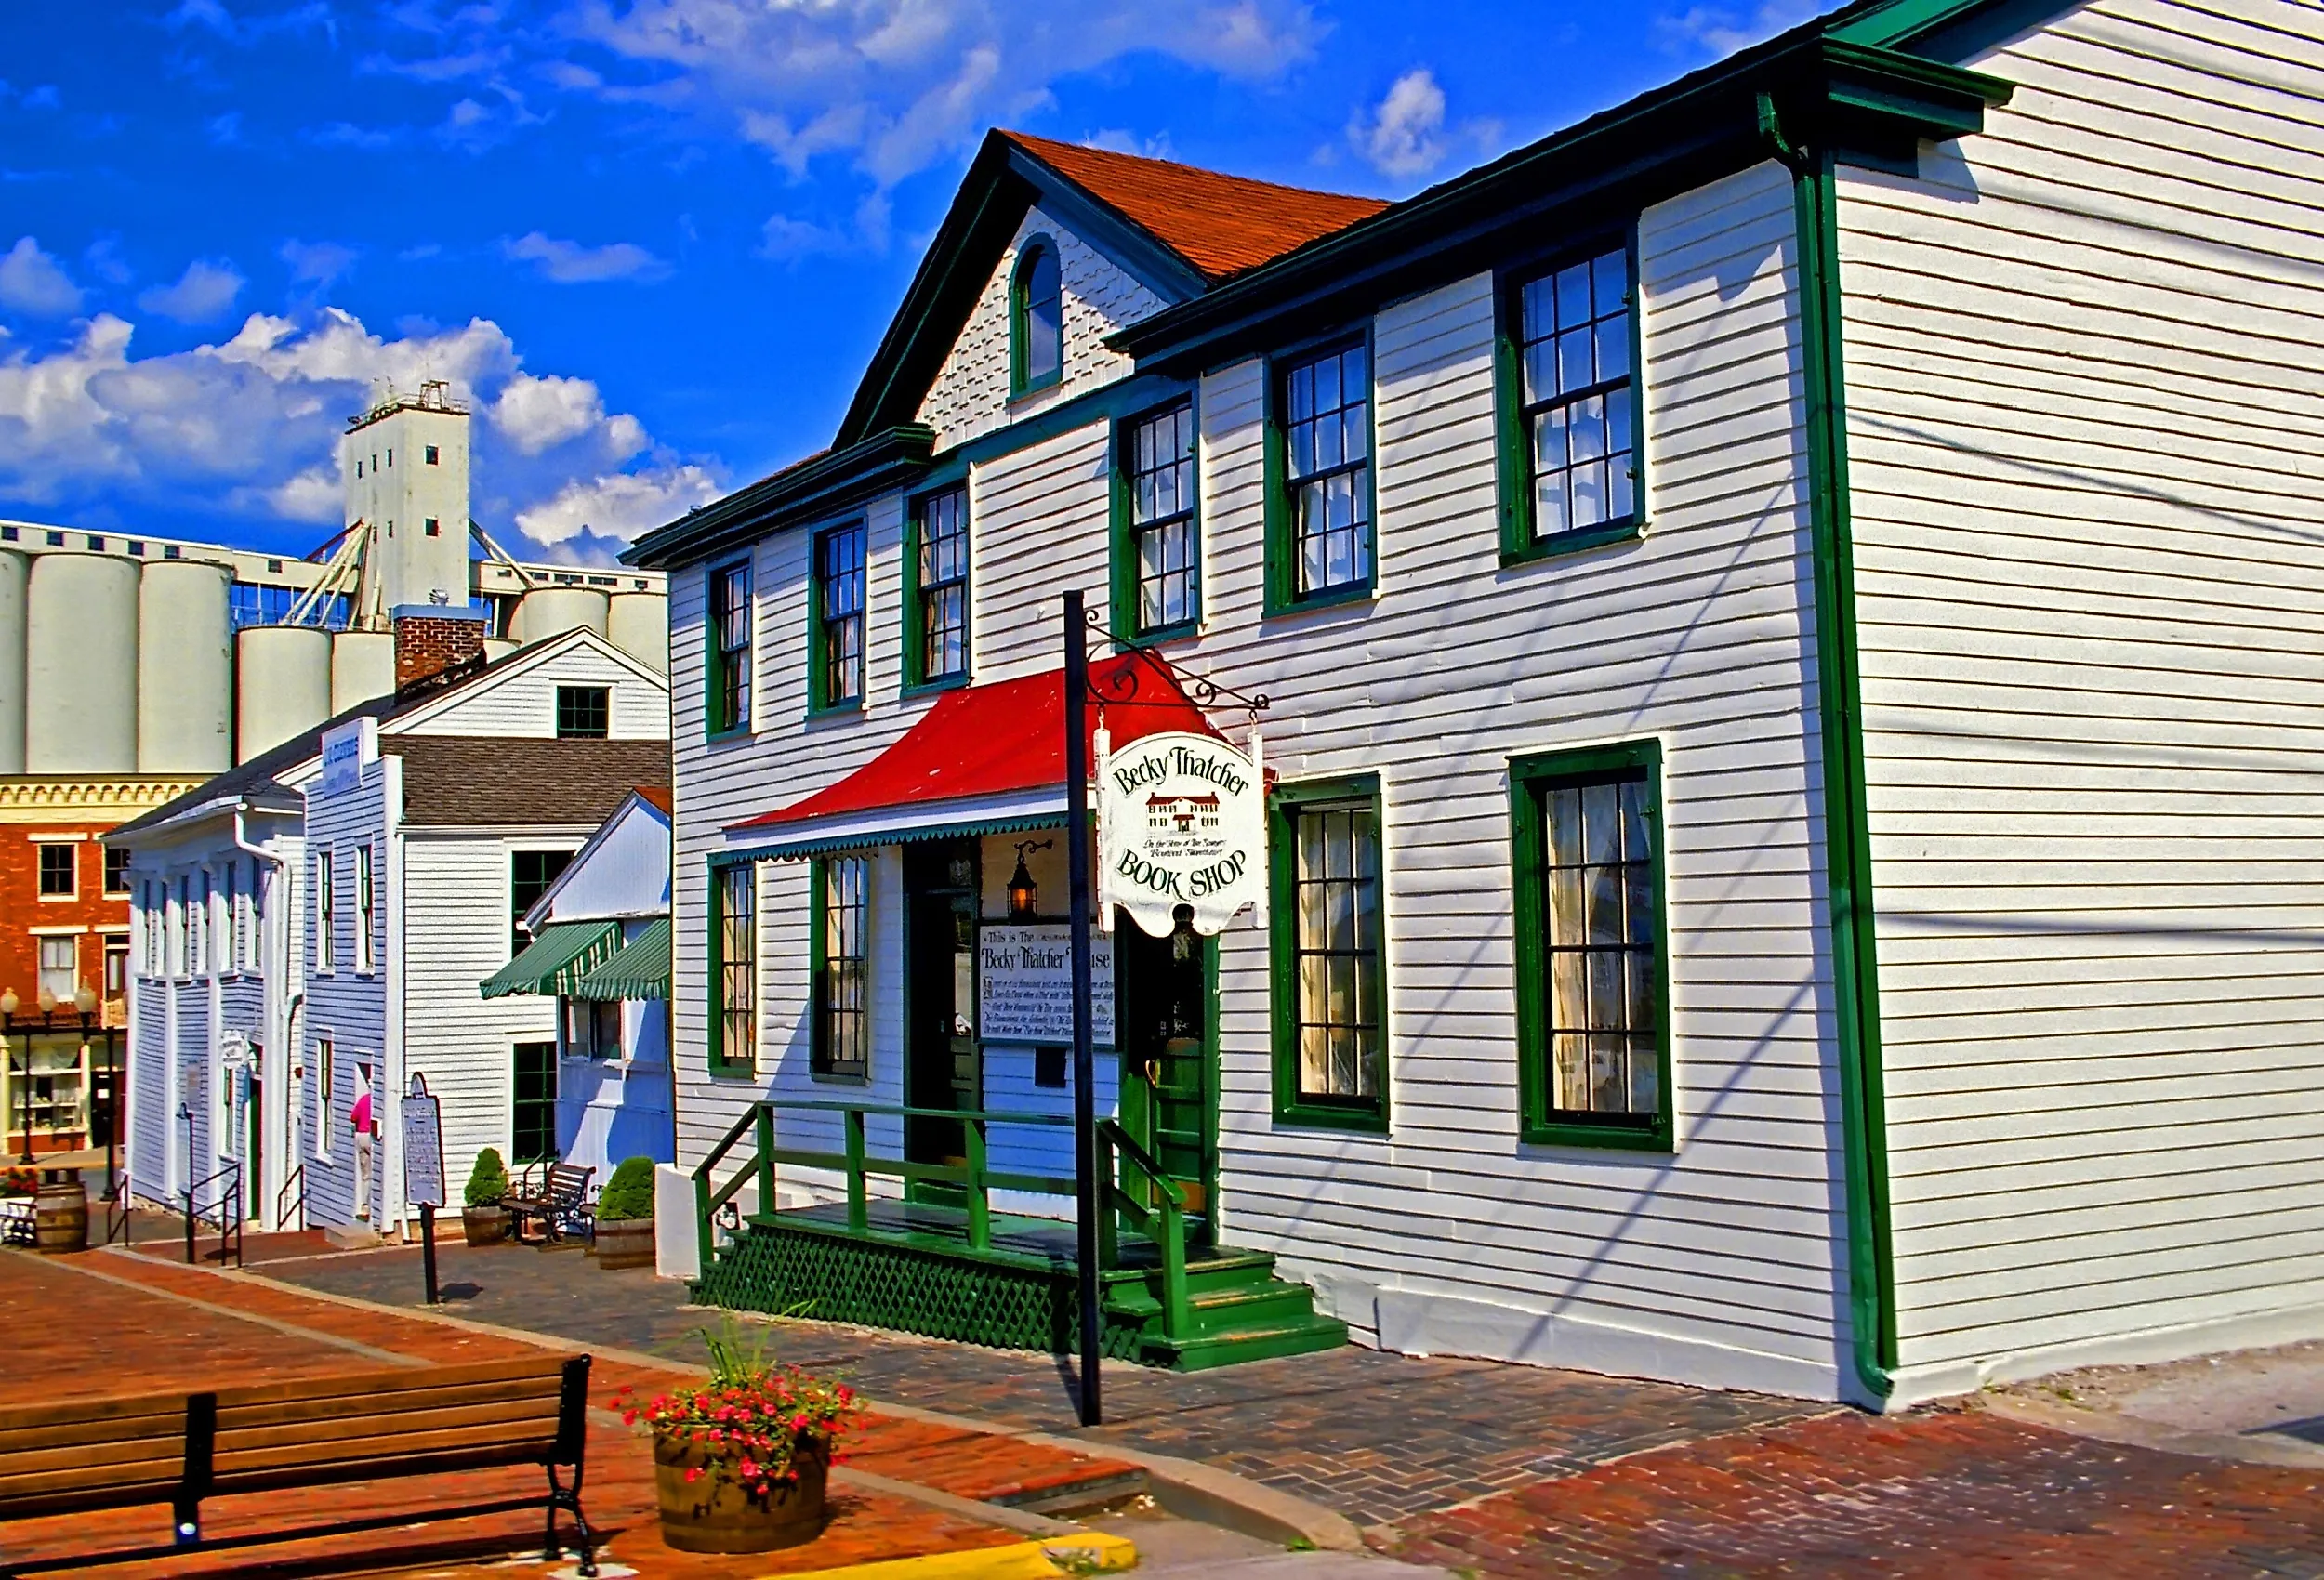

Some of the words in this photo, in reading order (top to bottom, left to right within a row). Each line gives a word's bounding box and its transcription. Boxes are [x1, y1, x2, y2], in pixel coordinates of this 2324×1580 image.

[1113, 754, 1169, 796] Becky
[1169, 746, 1249, 797] Thatcher
[1116, 849, 1191, 902] BOOK
[1190, 849, 1247, 897] SHOP
[988, 931, 1006, 943] This
[1020, 931, 1034, 943] The
[981, 947, 1016, 971] Becky
[1017, 946, 1064, 968] Thatcher
